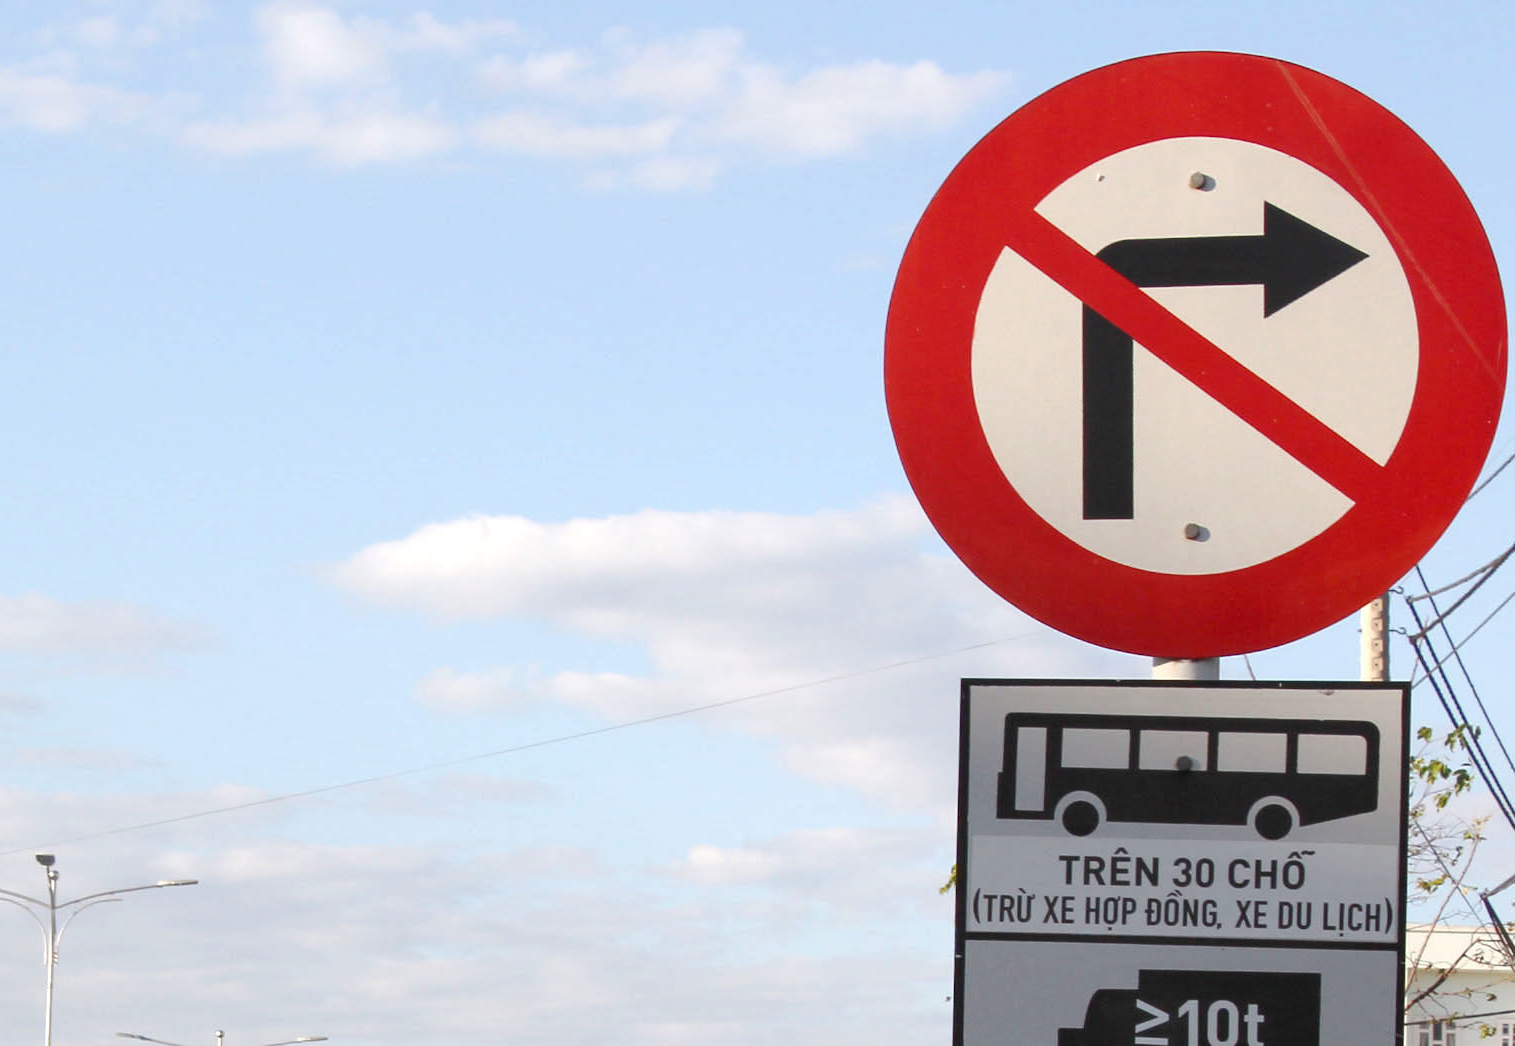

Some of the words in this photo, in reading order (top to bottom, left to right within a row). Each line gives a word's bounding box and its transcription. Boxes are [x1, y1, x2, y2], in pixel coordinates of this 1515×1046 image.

[1059, 847, 1159, 887] TRÊN
[1172, 857, 1215, 888] 30
[1228, 850, 1316, 890] CHỖ
[973, 887, 1035, 924] (TRỪ
[1043, 895, 1075, 924] XE
[1085, 896, 1136, 931] HỢP
[1145, 889, 1222, 929] ĐỒNG,
[1235, 900, 1268, 929] XE
[1278, 901, 1312, 930] DU
[1323, 897, 1394, 937] LỊCH)
